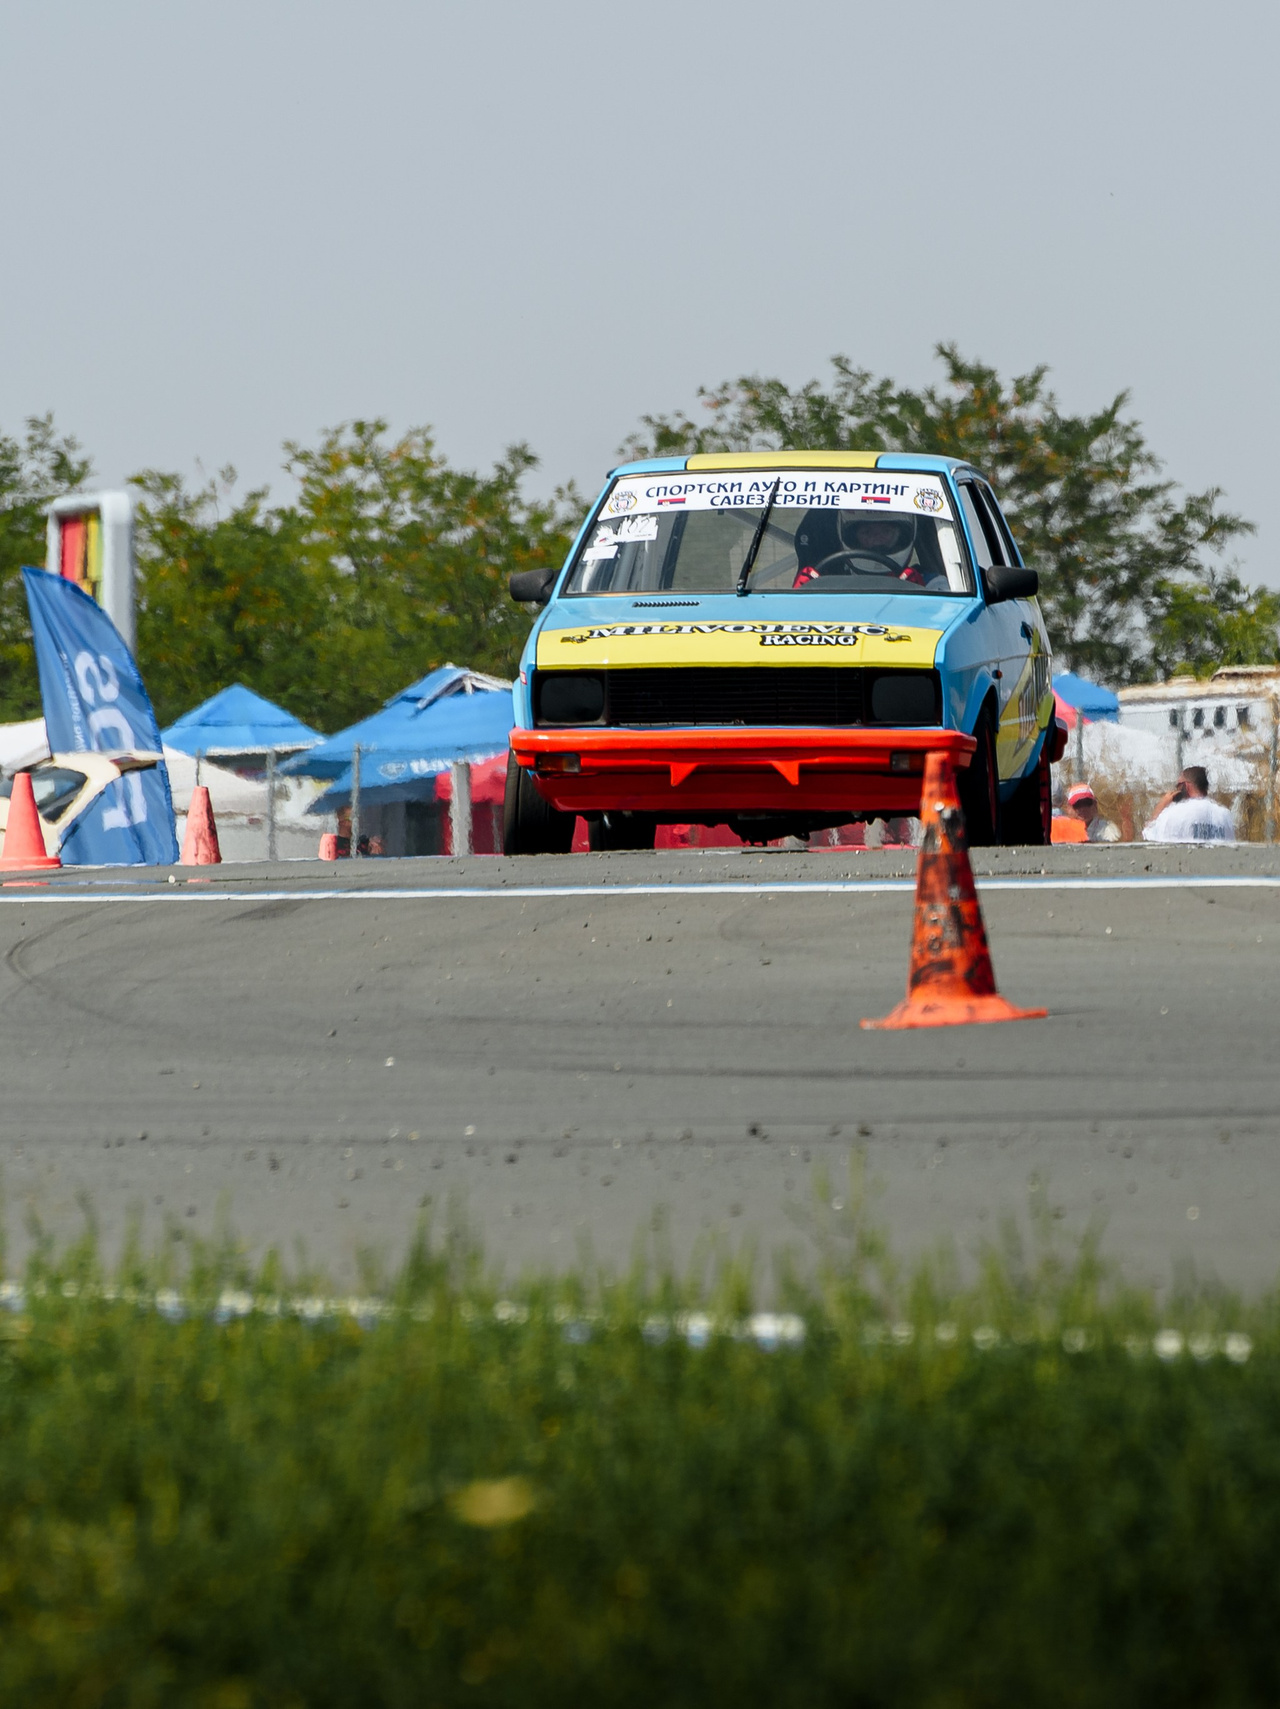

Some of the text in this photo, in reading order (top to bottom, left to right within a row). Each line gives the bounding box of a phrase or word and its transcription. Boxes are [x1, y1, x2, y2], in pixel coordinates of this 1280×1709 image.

[645, 481, 909, 498] СПОРТСКИ АУТО И КАРТИНГ
[710, 494, 840, 506] САВЕЗ СРБИЈЕ
[761, 634, 858, 646] RACING
